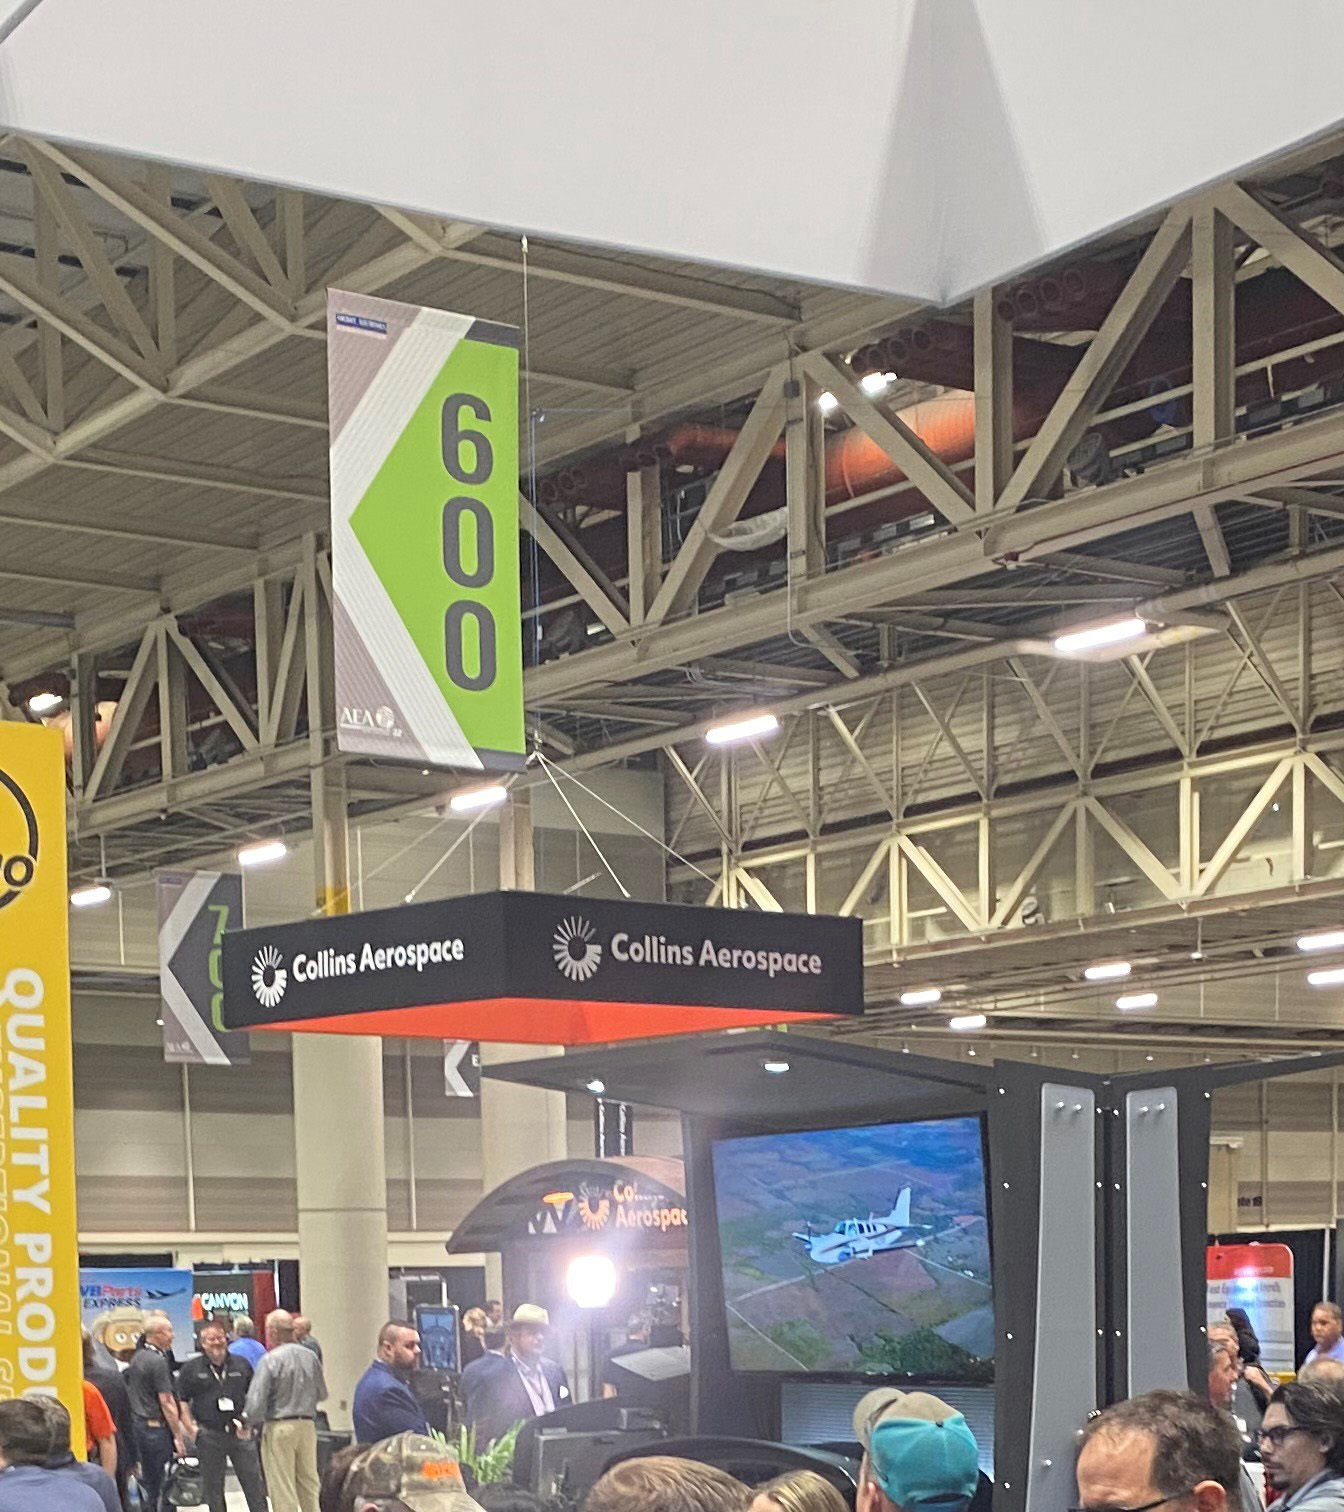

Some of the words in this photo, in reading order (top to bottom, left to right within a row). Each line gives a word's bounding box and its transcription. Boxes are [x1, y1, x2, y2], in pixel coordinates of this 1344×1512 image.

[440, 392, 497, 692] 600
[292, 947, 357, 983] Collins
[359, 938, 465, 973] Aerospace
[610, 932, 694, 967] Collins
[698, 939, 823, 978] Aerospace
[201, 1292, 249, 1312] CANYON
